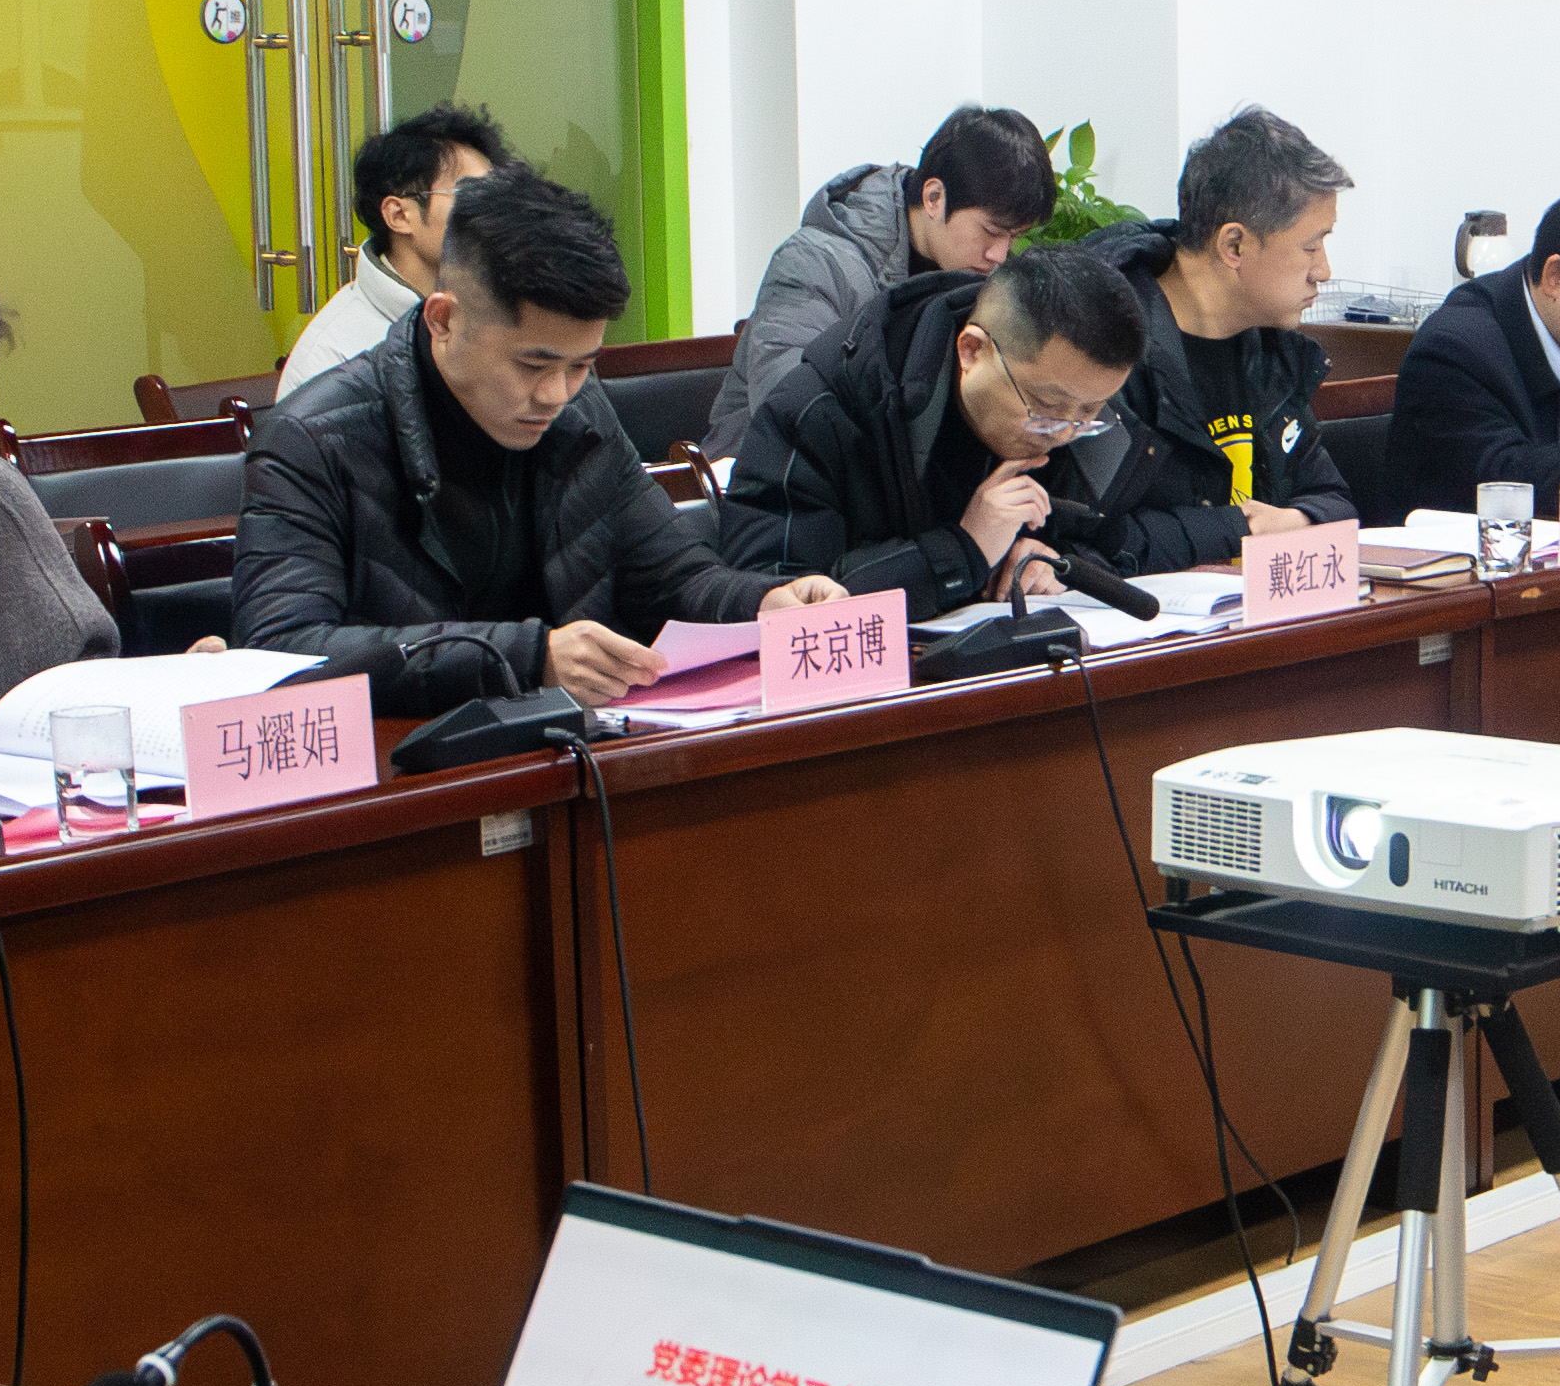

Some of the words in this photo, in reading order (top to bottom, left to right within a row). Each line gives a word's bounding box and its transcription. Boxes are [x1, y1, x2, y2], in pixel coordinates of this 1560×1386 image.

[1268, 542, 1348, 599] 戴红永
[790, 613, 888, 680] 宋京博
[215, 705, 341, 782] 马耀娟
[1433, 878, 1489, 896] HITACHI
